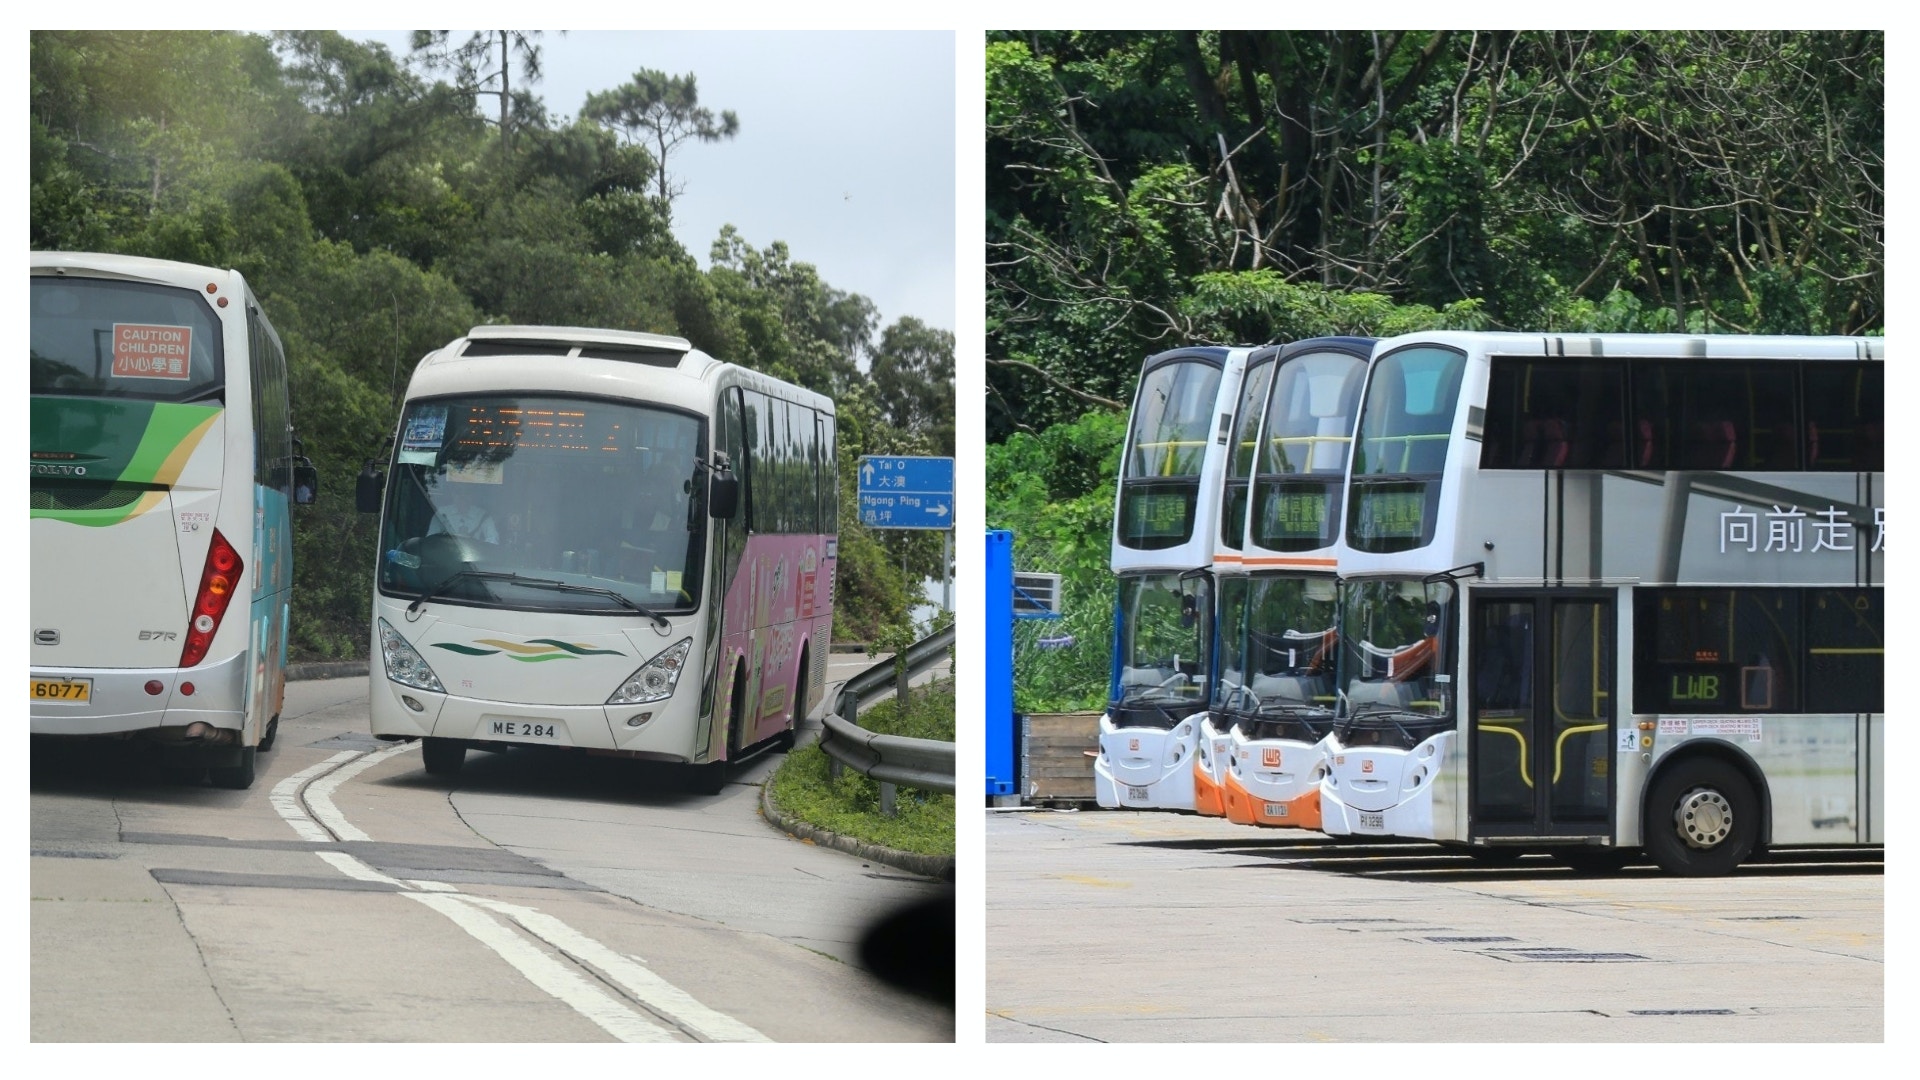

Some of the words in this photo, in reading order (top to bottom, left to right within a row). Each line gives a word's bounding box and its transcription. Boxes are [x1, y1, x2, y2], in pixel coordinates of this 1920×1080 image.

[122, 329, 182, 342] CAUTION
[119, 342, 185, 355] CHILDREN
[118, 356, 183, 374] 小心學童
[879, 460, 892, 470] Tai
[897, 460, 905, 470] O
[878, 475, 906, 488] 大澳
[864, 495, 894, 507] Ngong
[900, 496, 921, 507] Ping
[864, 510, 892, 522] 昂坪
[1719, 504, 1855, 553] 向前走
[35, 683, 85, 698] 6077
[1672, 675, 1719, 700] LWB
[493, 722, 515, 735] ME
[522, 724, 555, 737] 284
[1262, 747, 1282, 767] LWB
